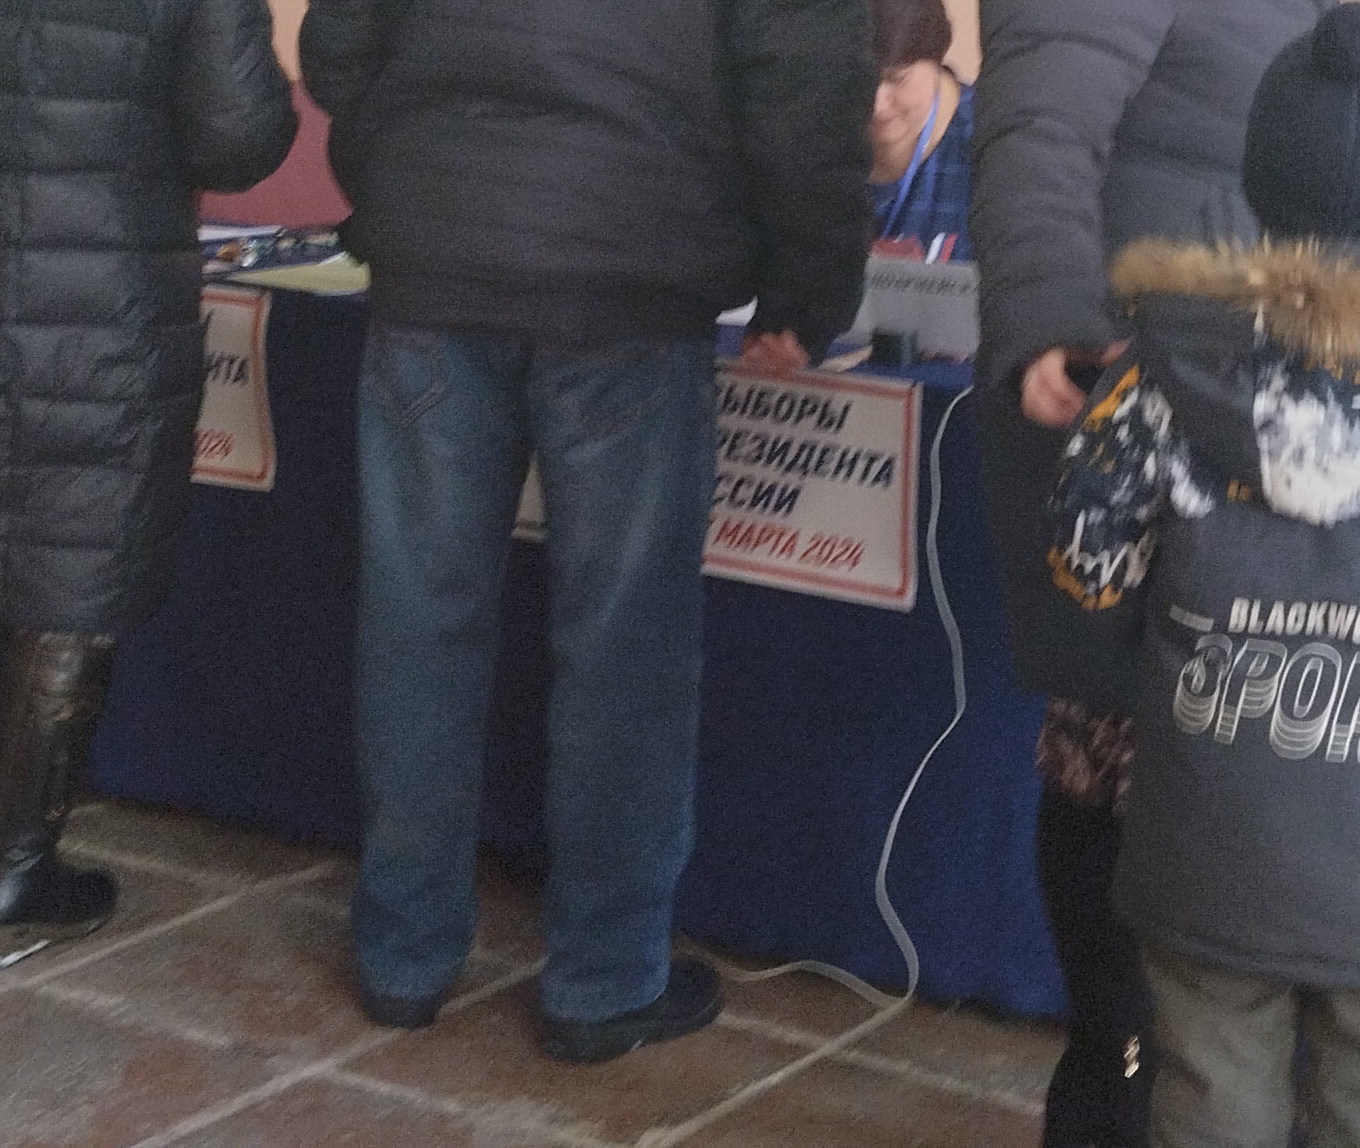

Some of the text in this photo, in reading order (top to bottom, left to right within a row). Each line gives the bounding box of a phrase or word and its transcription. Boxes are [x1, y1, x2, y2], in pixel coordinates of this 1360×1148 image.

[717, 383, 854, 434] ЫБОРЫ
[713, 517, 866, 572] МАРТА 2024
